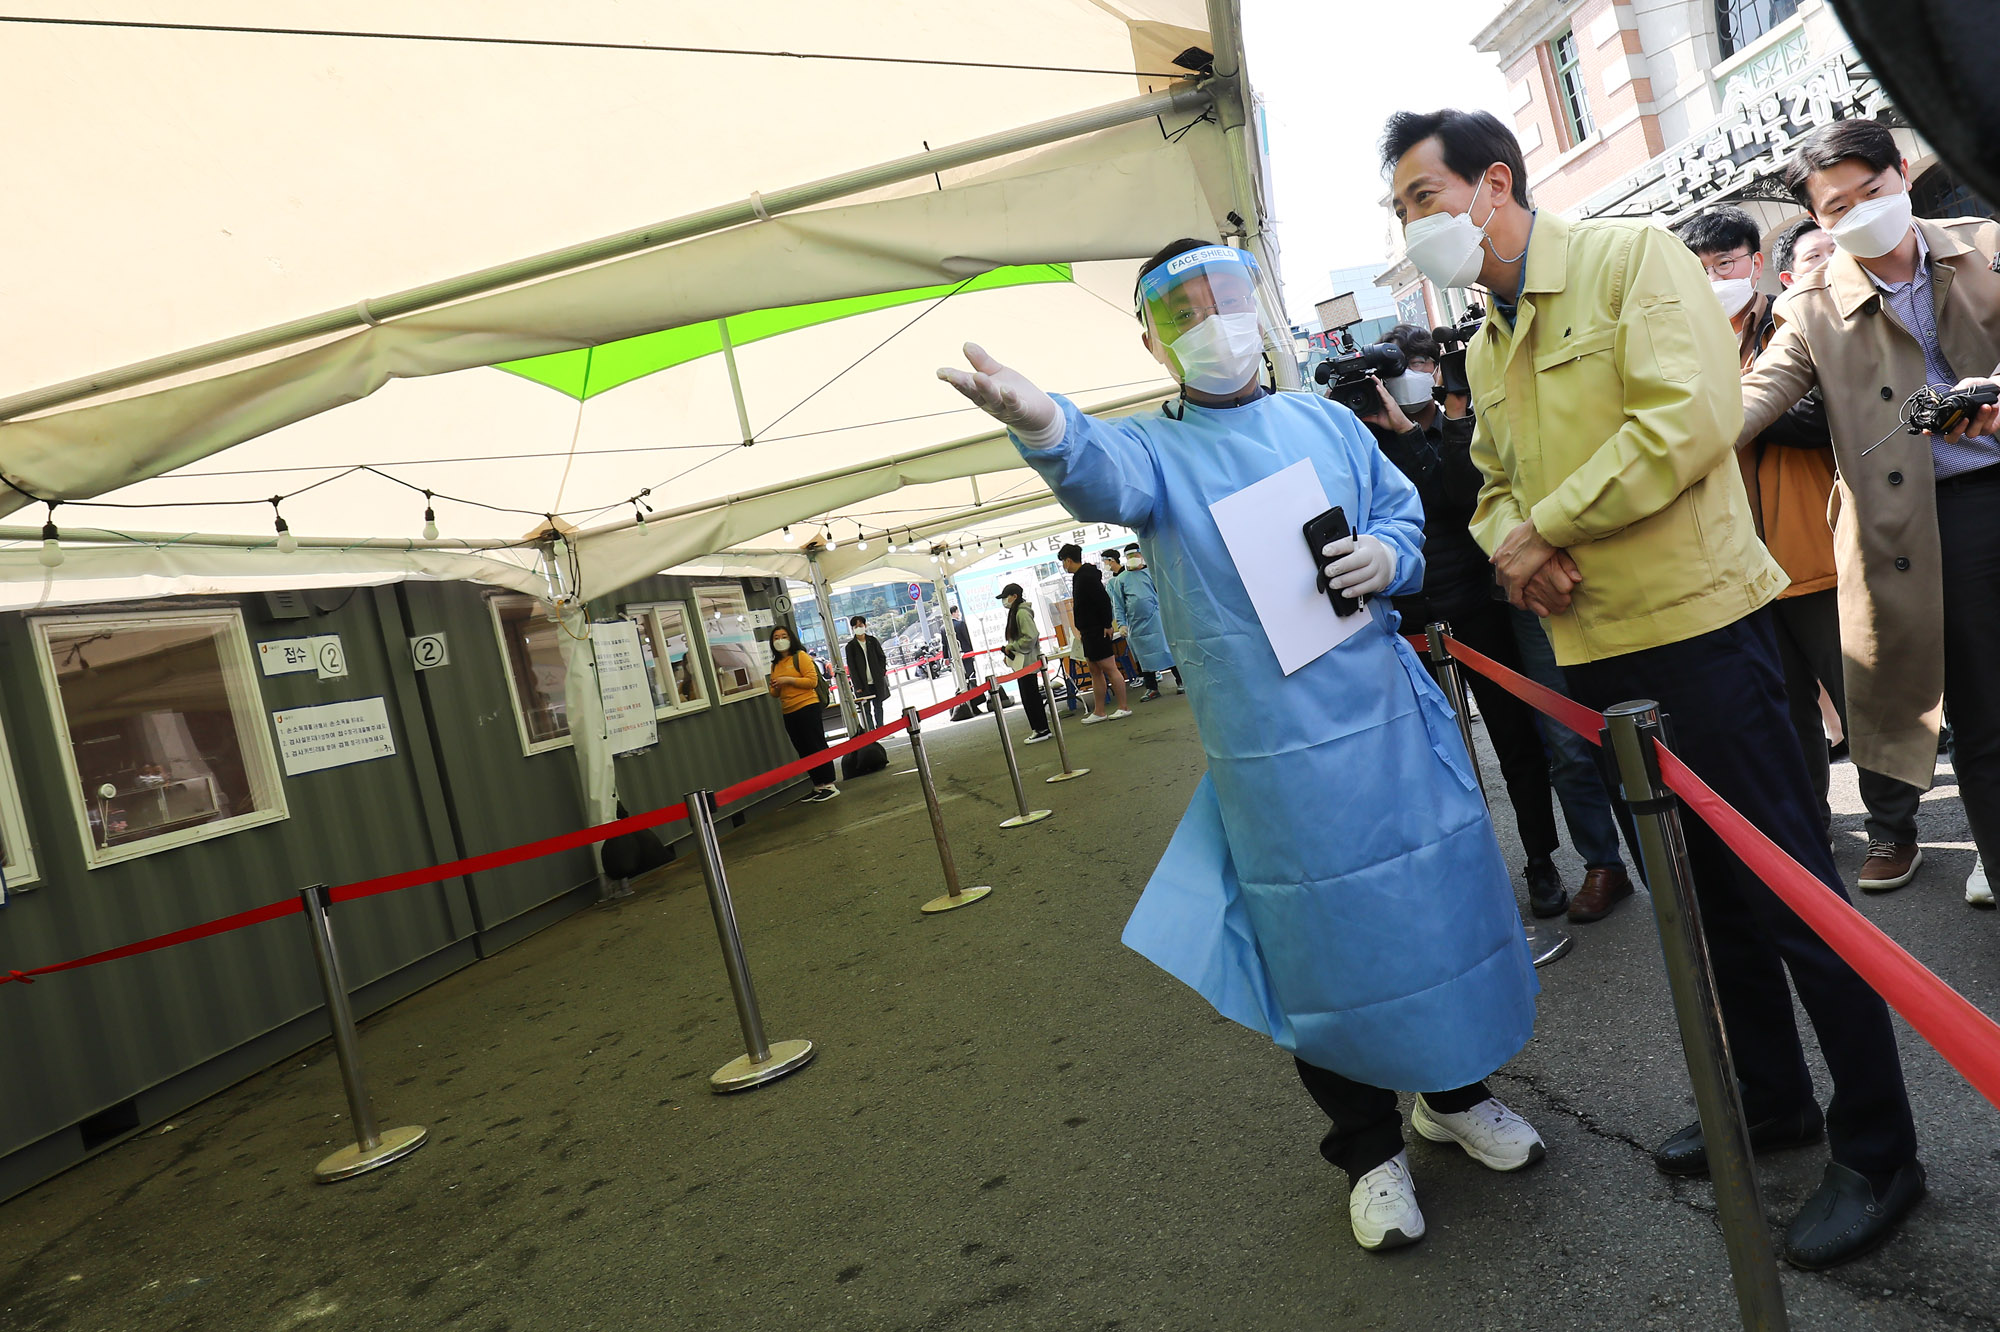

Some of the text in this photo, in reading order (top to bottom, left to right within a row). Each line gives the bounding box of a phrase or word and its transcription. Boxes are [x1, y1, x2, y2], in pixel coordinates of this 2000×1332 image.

[1172, 249, 1234, 269] FACE SHIELD
[284, 648, 306, 664] 접수
